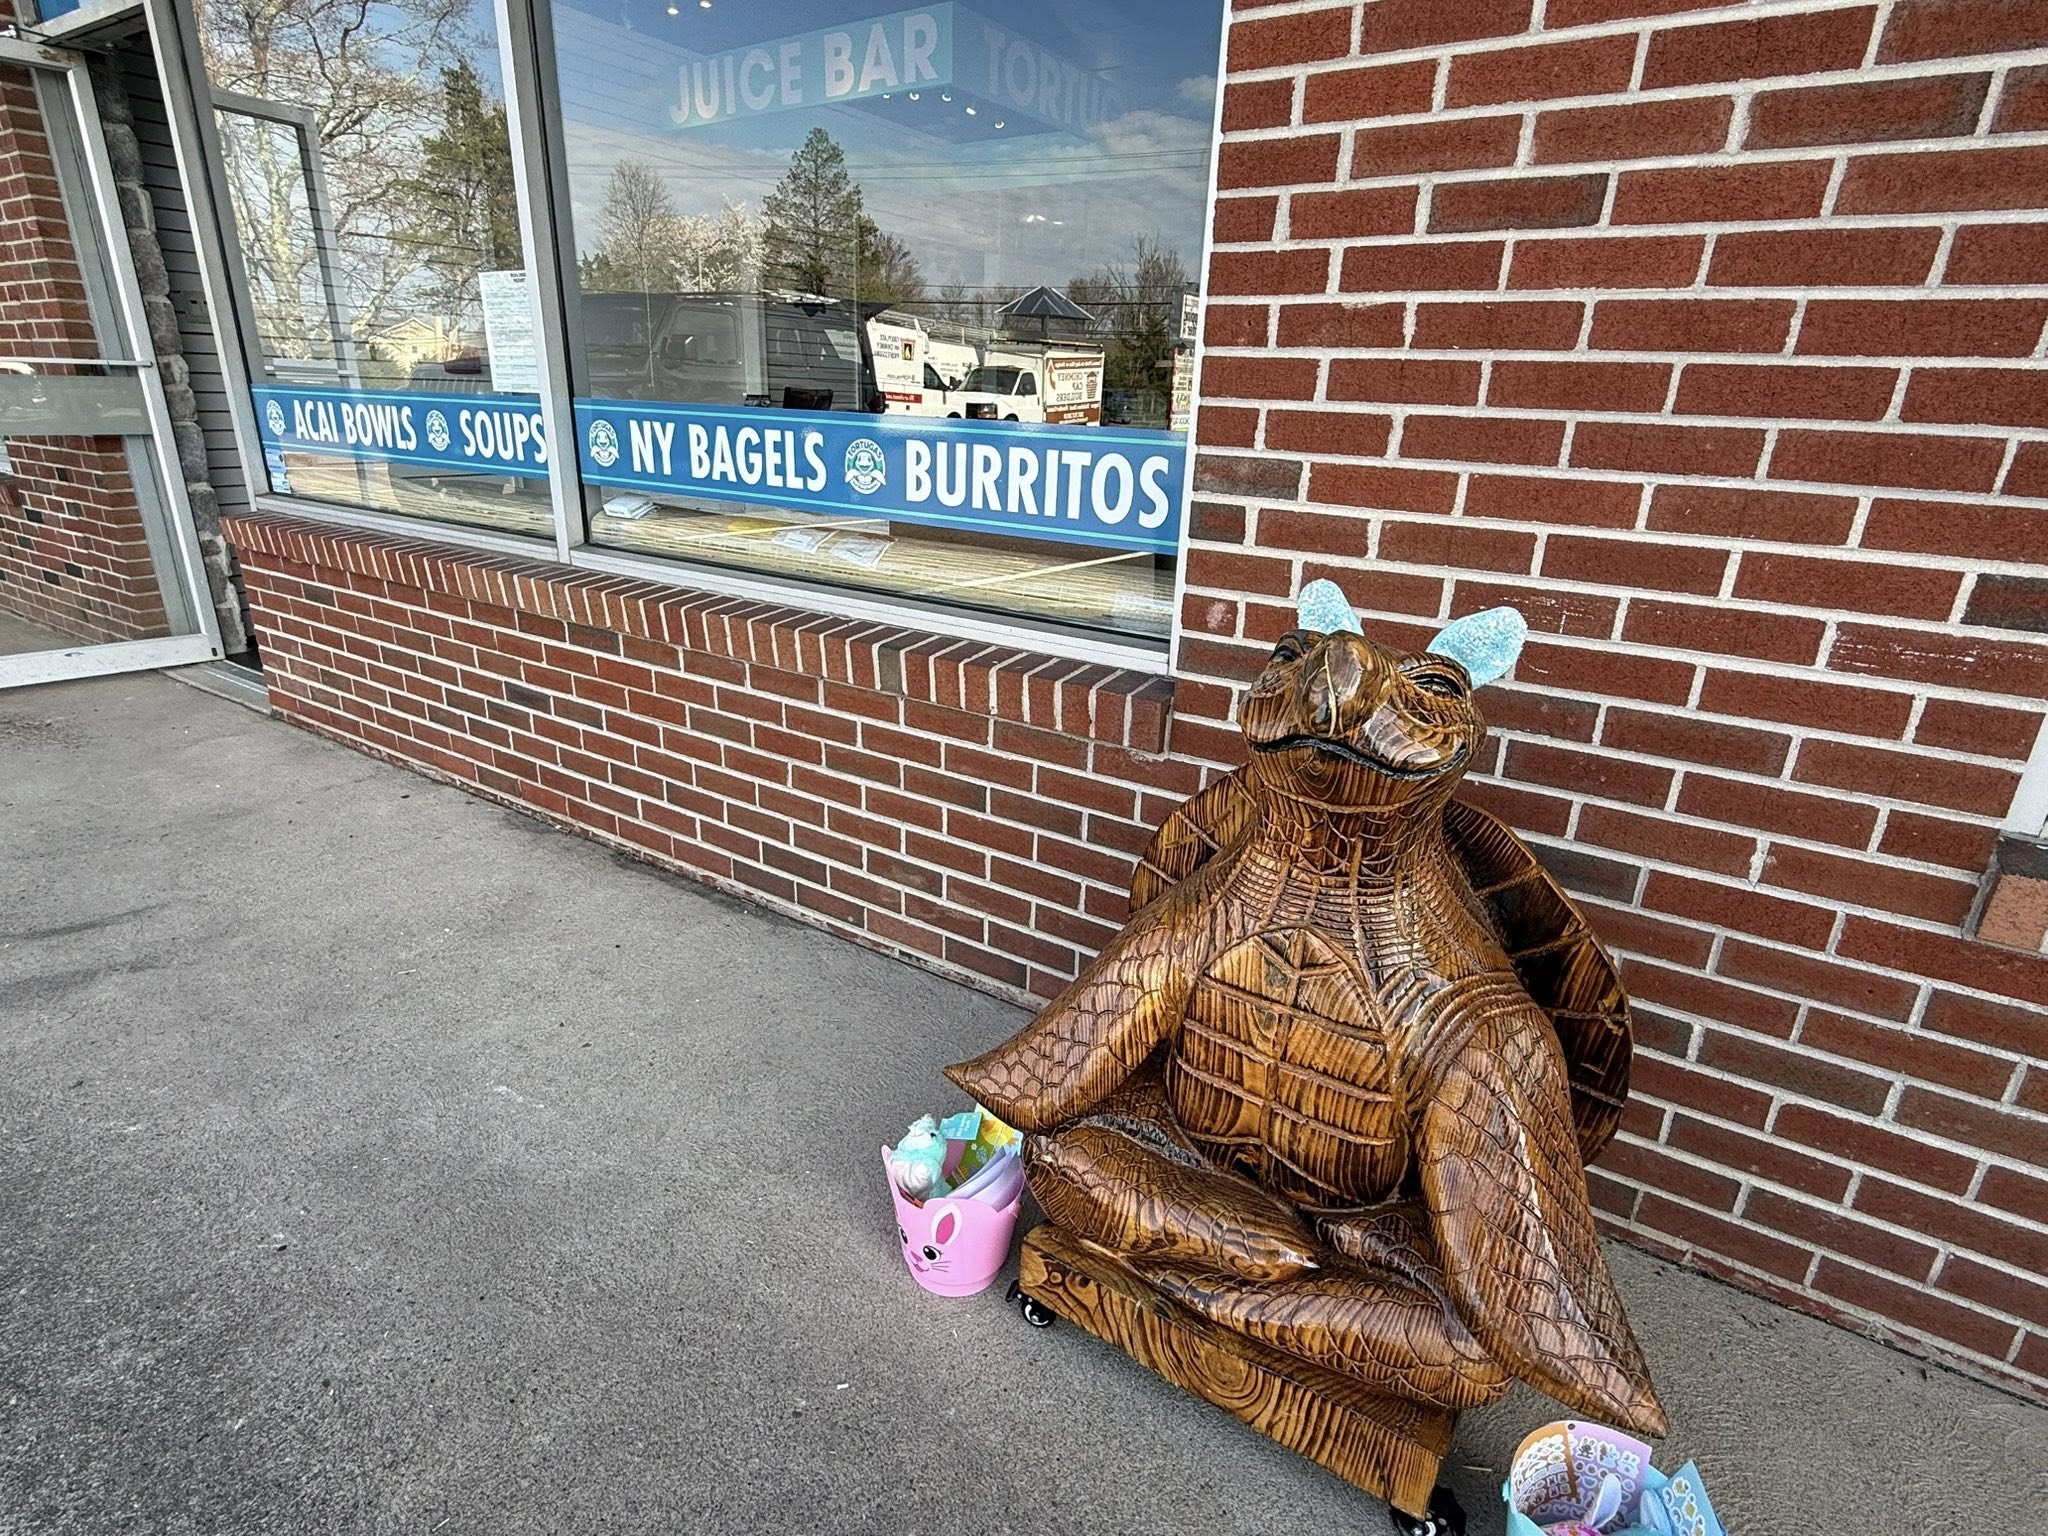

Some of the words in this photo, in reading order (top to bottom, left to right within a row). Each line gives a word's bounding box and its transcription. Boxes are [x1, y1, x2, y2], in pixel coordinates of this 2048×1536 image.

[669, 42, 803, 124] JUICE
[823, 13, 938, 98] BAR
[293, 399, 340, 444] ACAI
[340, 402, 417, 451] BOWLS
[459, 408, 548, 464] SOUPS
[629, 420, 675, 475] NY
[688, 422, 828, 492] BAGELS
[848, 440, 883, 459] TORTUGAS
[905, 438, 1170, 529] BURRITOS
